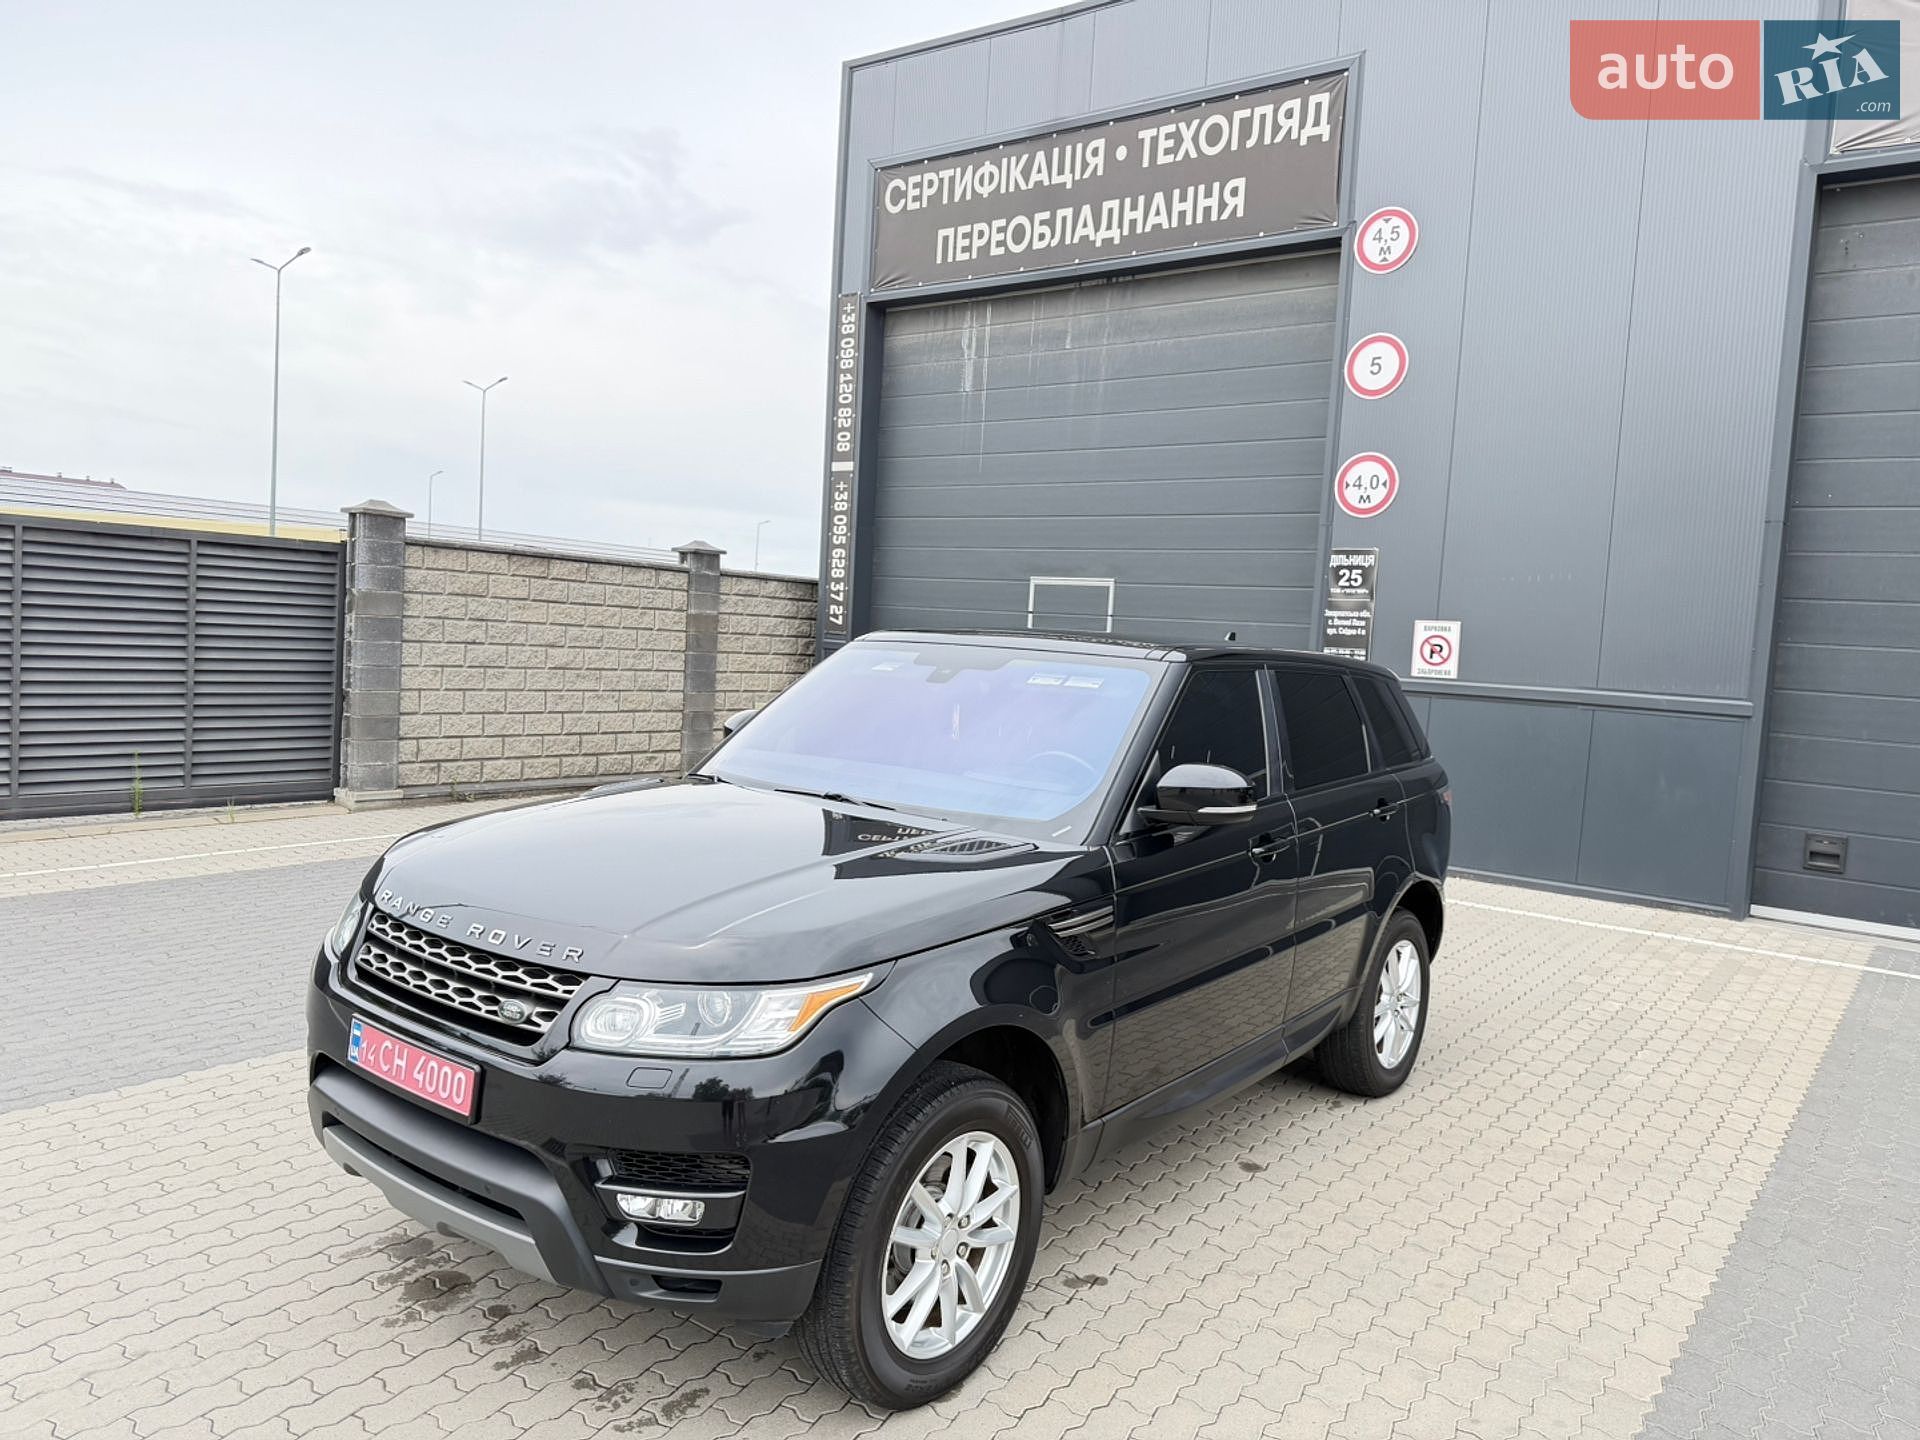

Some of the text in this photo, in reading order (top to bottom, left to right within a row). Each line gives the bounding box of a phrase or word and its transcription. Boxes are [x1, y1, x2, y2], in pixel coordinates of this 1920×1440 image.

[884, 91, 1332, 214] СЕРТИФІКАЦІЯ ТЕХОГЛЯД
[935, 177, 1247, 265] ПЕРЕОБЛАДНАННЯ
[1371, 225, 1401, 246] 4,5
[836, 302, 855, 452] +38 098 120 82 08
[1369, 356, 1383, 376] 5
[1352, 474, 1380, 494] 4,0
[829, 481, 848, 625] +38 095 628 37 27
[1329, 554, 1375, 568] ДІЛЬНИЦЯ
[1337, 569, 1363, 587] 25
[380, 889, 585, 963] RANGE ROVER
[360, 1040, 377, 1066] 14
[379, 1039, 408, 1081] CH
[413, 1058, 467, 1105] 4000
